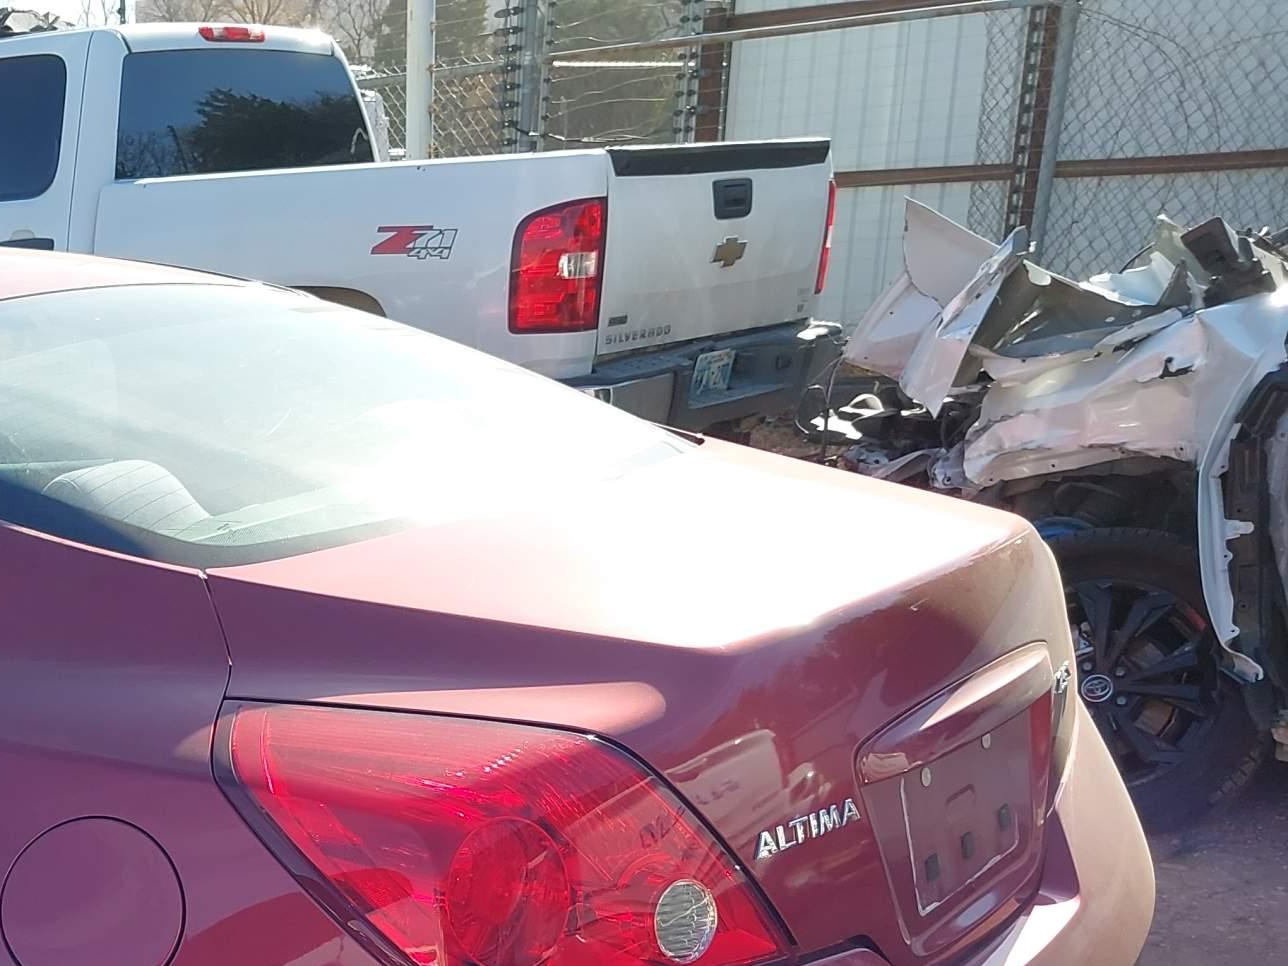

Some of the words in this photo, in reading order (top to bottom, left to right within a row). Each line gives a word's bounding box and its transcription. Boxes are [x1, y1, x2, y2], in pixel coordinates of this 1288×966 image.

[370, 224, 458, 256] Z71
[605, 324, 672, 345] SILVERADO
[754, 798, 862, 861] ALTIMA
